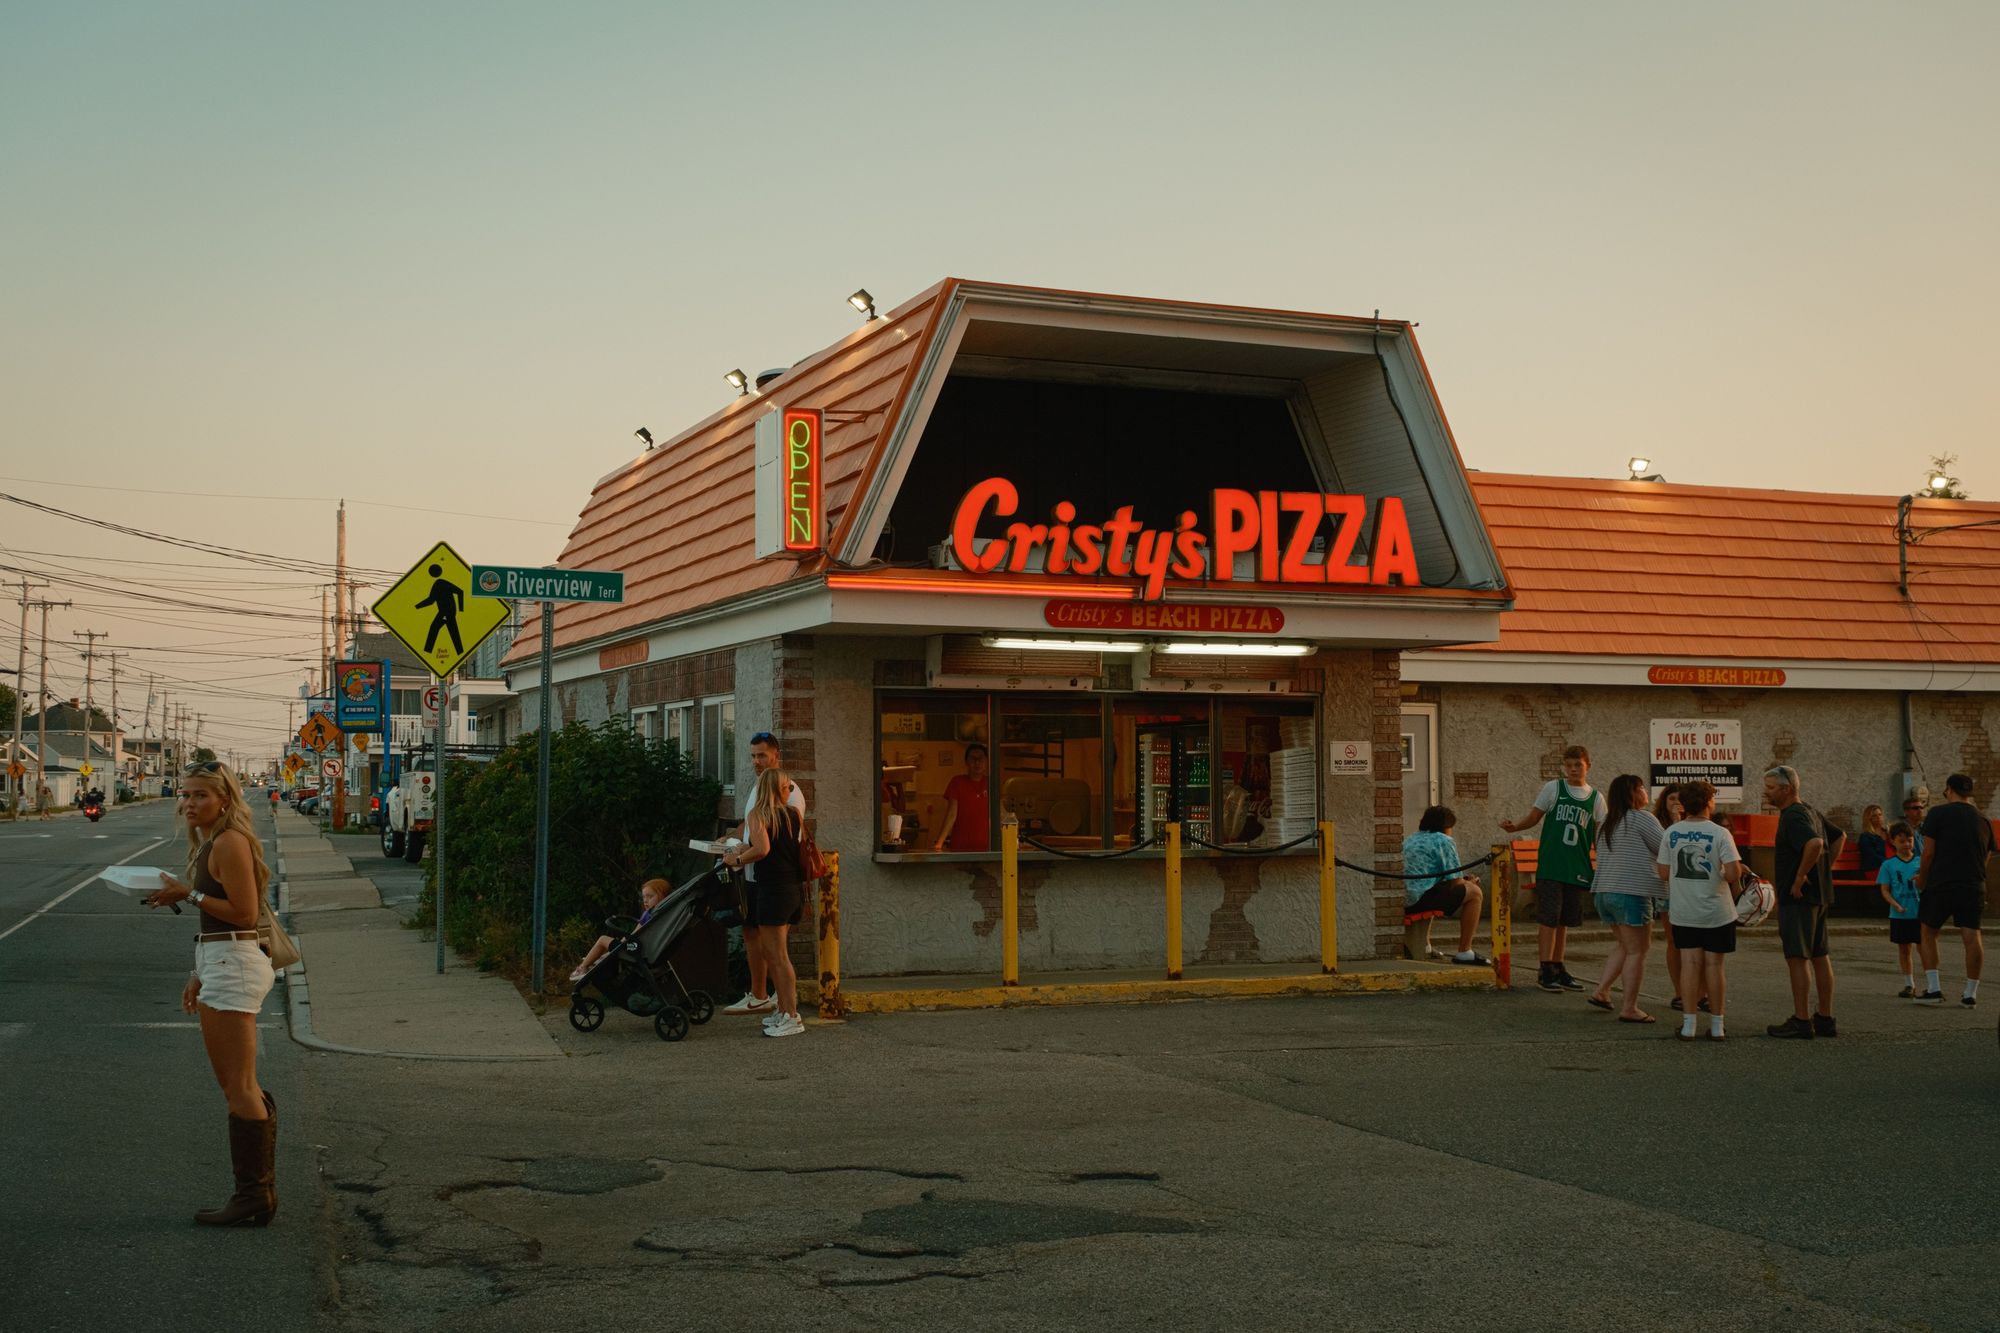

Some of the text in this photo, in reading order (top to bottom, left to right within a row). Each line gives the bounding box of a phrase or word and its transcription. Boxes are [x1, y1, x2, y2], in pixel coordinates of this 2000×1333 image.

[789, 420, 811, 542] OPEN
[950, 477, 1421, 601] Cristy's PIZZA
[506, 571, 617, 599] Riverview Terr
[1057, 603, 1273, 630] Cristy's BEACH PIZZA
[1655, 667, 1780, 685] Cristy's BEACH PIZZA
[1667, 733, 1726, 746] TAKE OUT
[1656, 748, 1738, 761] PARKING ONLY
[1666, 766, 1728, 774] UNATTENDED CARS
[1679, 776, 1688, 784] TO
[1712, 776, 1738, 784] GARAGE
[1556, 804, 1592, 830] BOSTON
[1562, 823, 1579, 847] 0
